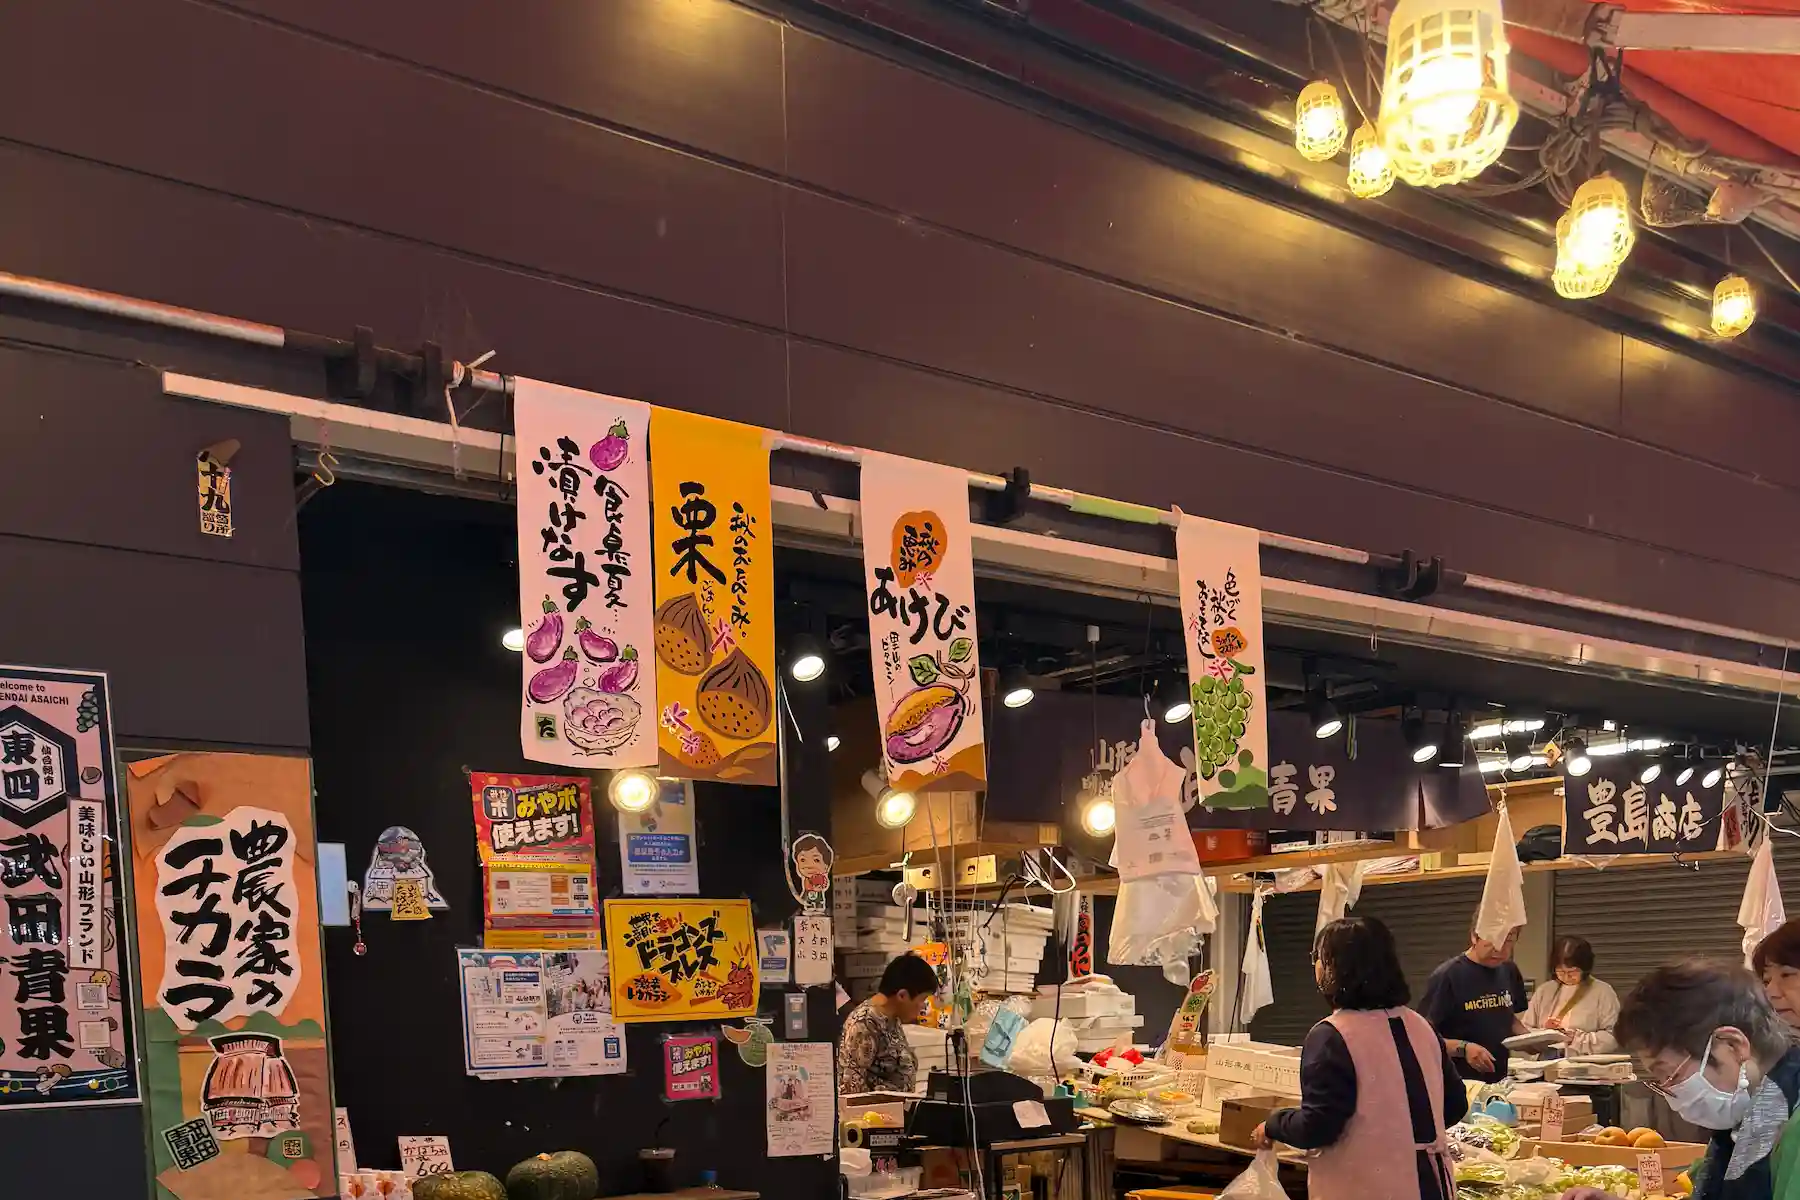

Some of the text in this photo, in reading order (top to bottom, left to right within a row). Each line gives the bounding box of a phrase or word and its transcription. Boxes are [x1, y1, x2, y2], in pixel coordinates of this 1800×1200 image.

[531, 436, 600, 613] 漬けなす
[670, 481, 727, 586] 栗
[870, 566, 971, 645] あけび
[1210, 586, 1227, 627] 秋の
[1223, 566, 1241, 622] 色づく
[0, 680, 46, 693] elcome to
[0, 692, 69, 706] ENDAI ASAICHI
[492, 812, 581, 851] 使えます!
[1583, 776, 1704, 846] 豊島商店
[78, 804, 96, 965] 美味しい山形ブランド
[229, 819, 294, 1009] 農家の
[0, 831, 76, 1061] 武田青果
[160, 837, 236, 1025] チカラ
[636, 910, 728, 970] ドラゴンズ
[1464, 995, 1507, 1011] MICHELIN
